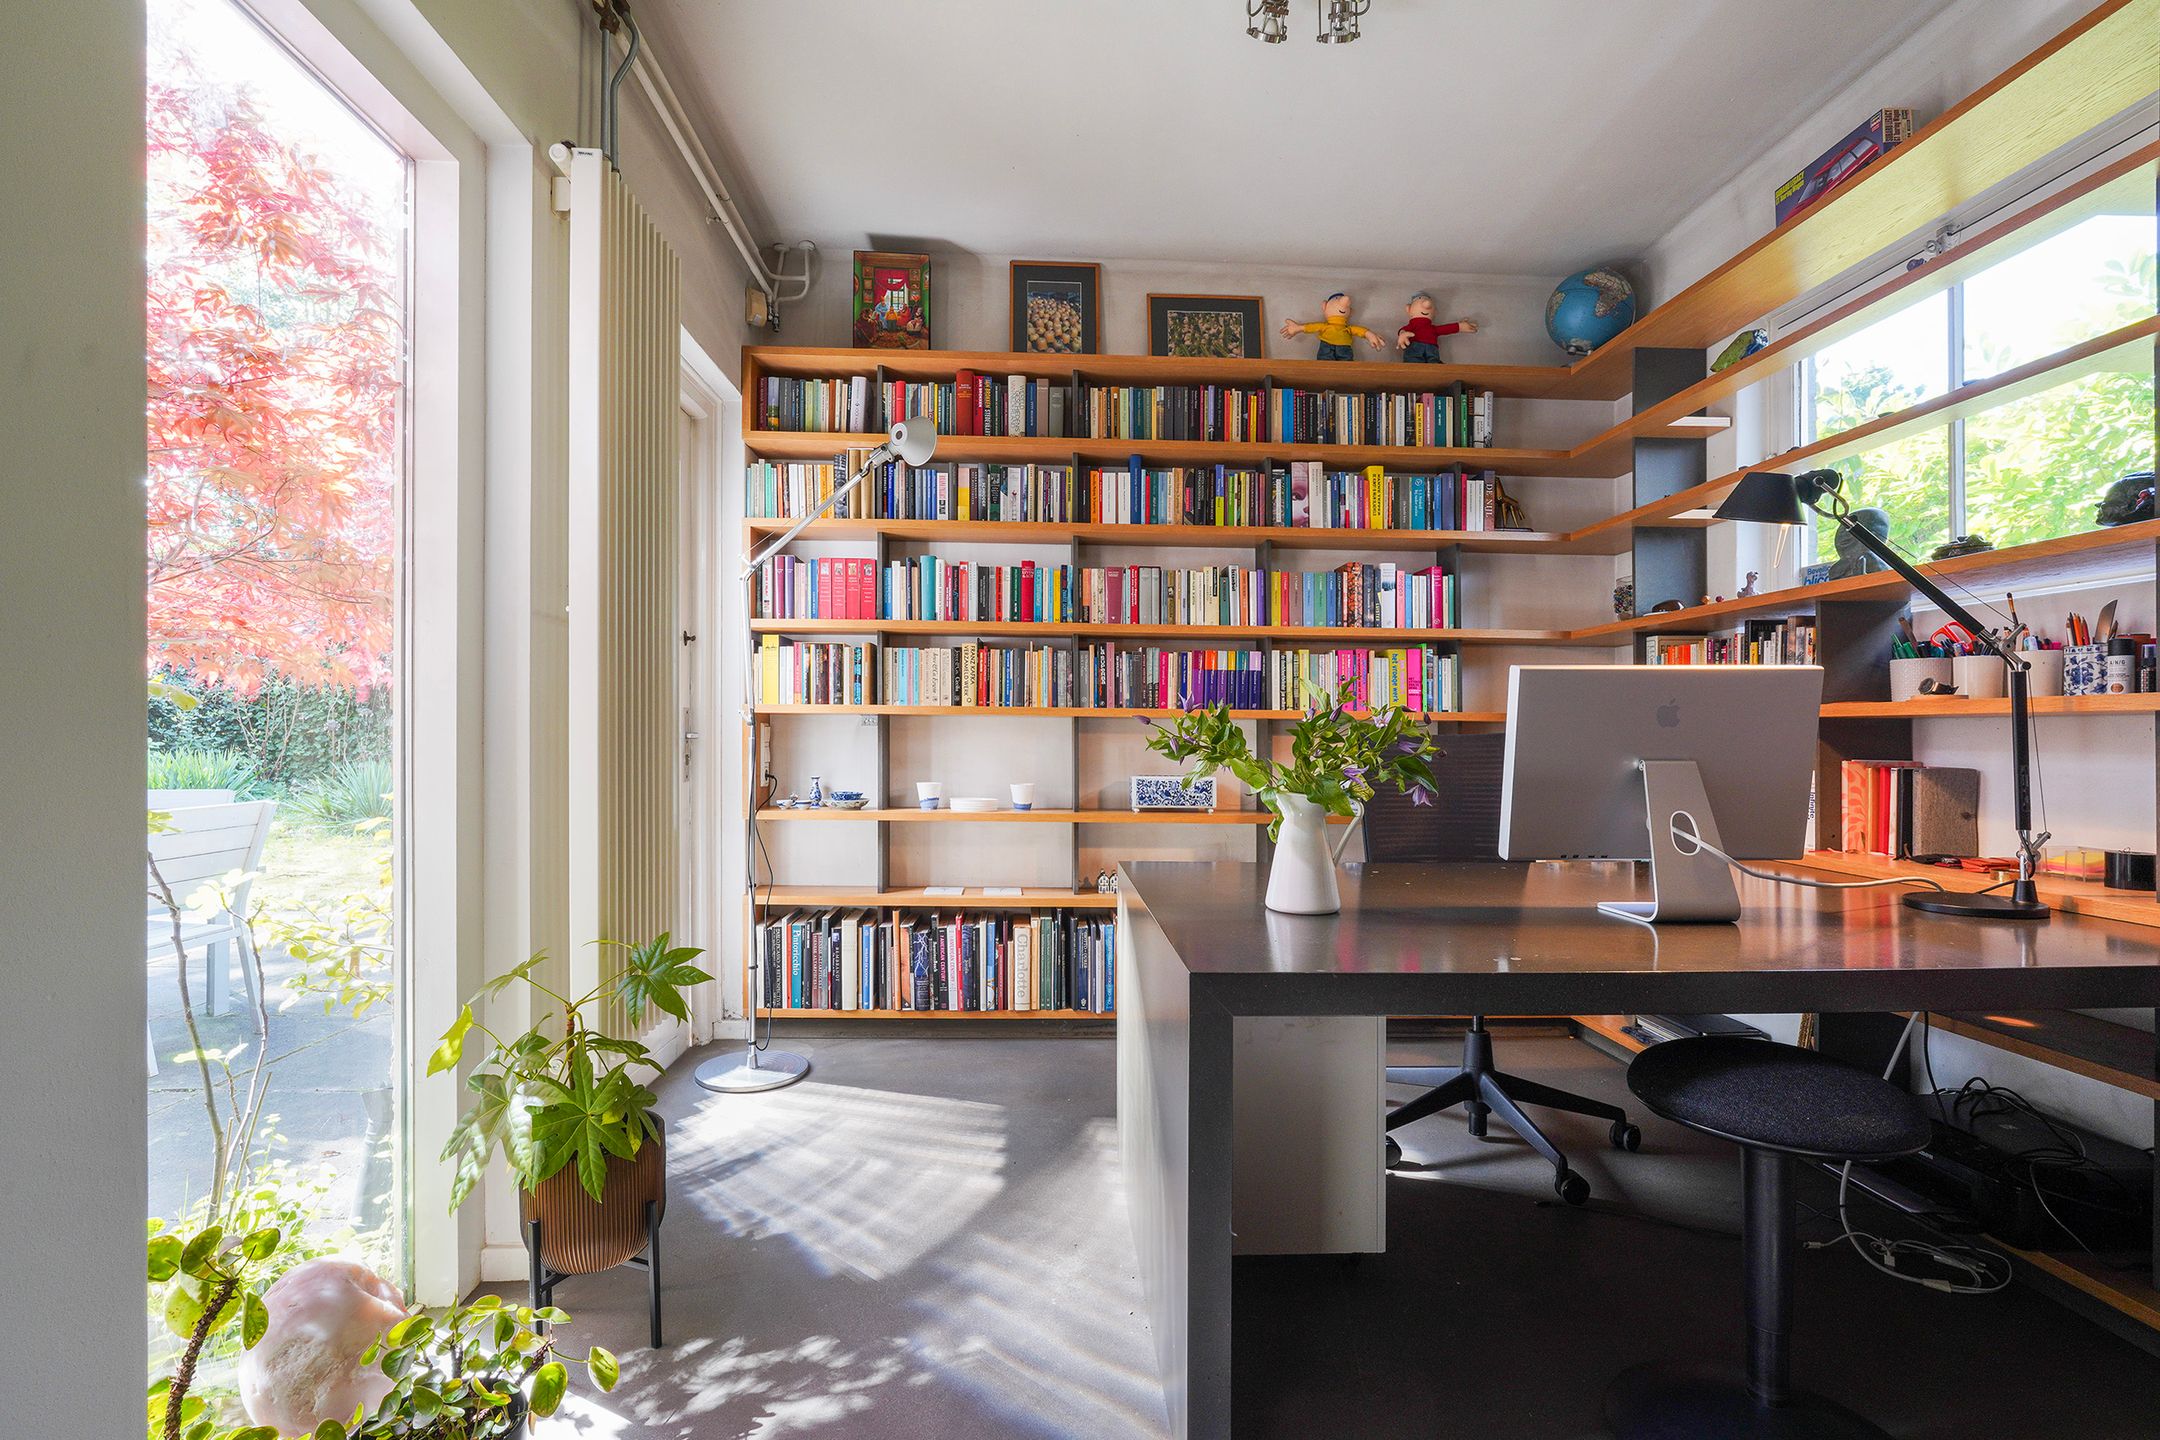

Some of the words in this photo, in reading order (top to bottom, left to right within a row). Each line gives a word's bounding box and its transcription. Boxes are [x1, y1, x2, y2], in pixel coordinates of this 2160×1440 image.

[1485, 484, 1493, 496] DE
[1485, 498, 1493, 518] NIJL
[1391, 666, 1399, 686] vroege
[792, 929, 801, 976] Pintoricchio
[1016, 934, 1028, 998] Charlotte
